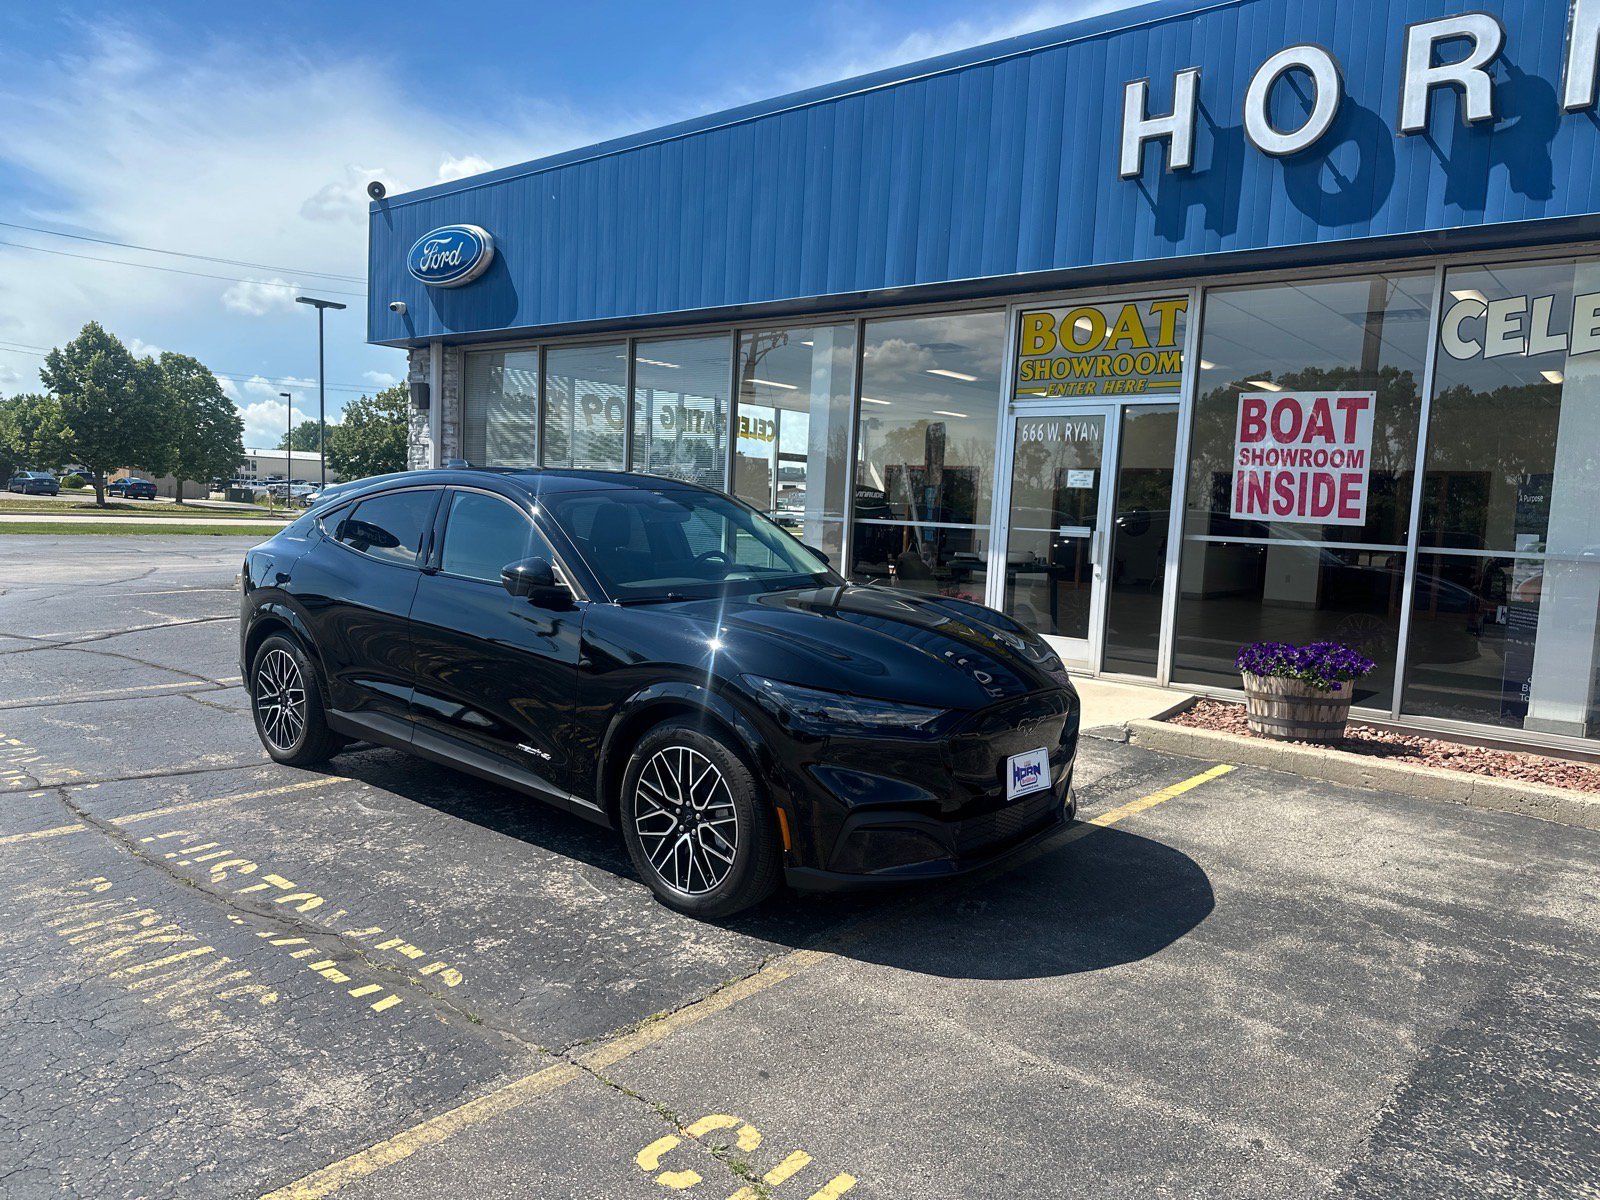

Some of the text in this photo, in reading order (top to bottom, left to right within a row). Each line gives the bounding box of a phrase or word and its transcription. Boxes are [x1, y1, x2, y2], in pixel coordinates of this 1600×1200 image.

[420, 237, 463, 271] Ford
[1020, 300, 1188, 356] BOAT
[1020, 351, 1182, 381] SHOWROOM
[1046, 378, 1149, 396] ENTER HERE
[1022, 422, 1099, 442] 666 W. RYAN
[1240, 398, 1369, 444] BOAT
[1238, 447, 1364, 468] SHOWROOM
[1235, 470, 1363, 519] INSIDE
